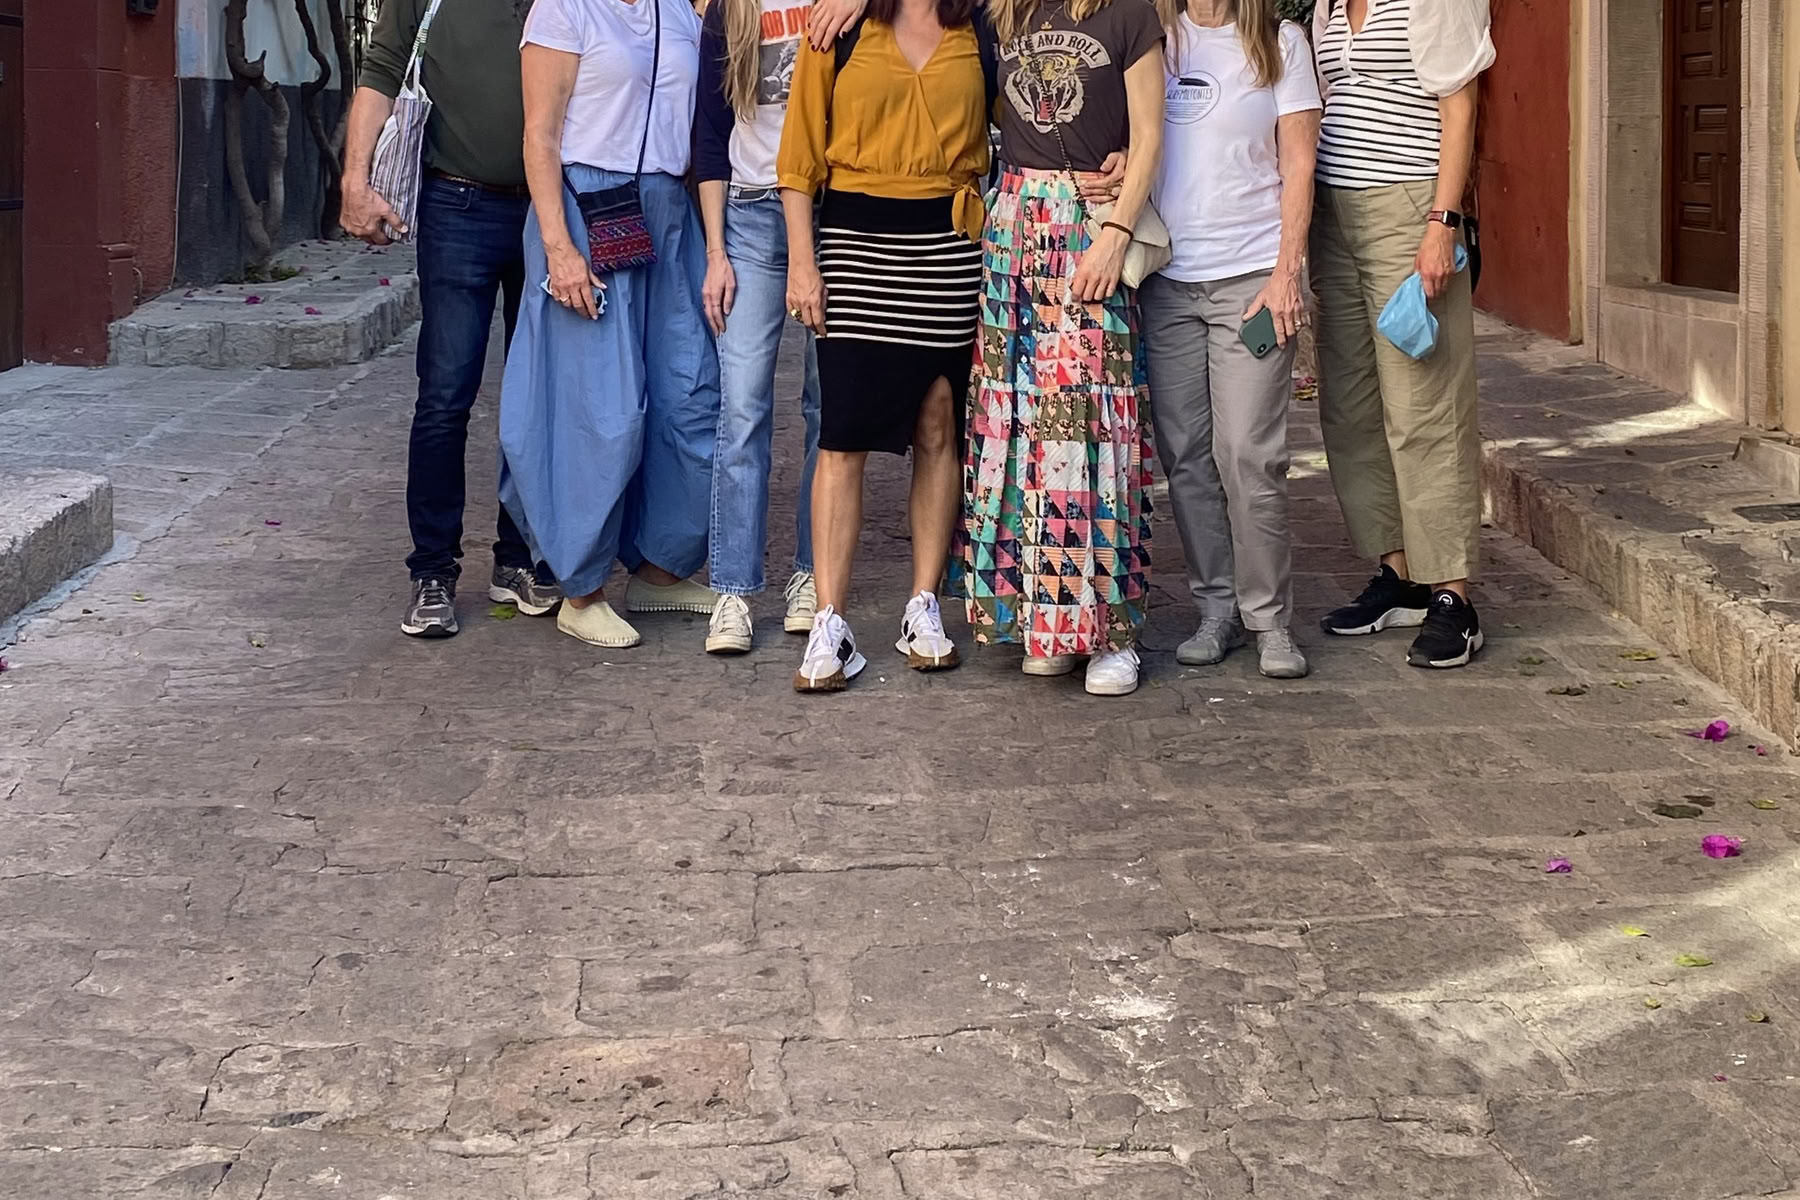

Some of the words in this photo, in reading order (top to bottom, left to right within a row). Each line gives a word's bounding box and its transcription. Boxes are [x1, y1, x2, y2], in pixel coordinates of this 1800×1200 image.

[760, 10, 785, 38] OB
[786, 5, 811, 34] DY
[1037, 33, 1064, 48] AND
[1067, 35, 1102, 63] ROLL
